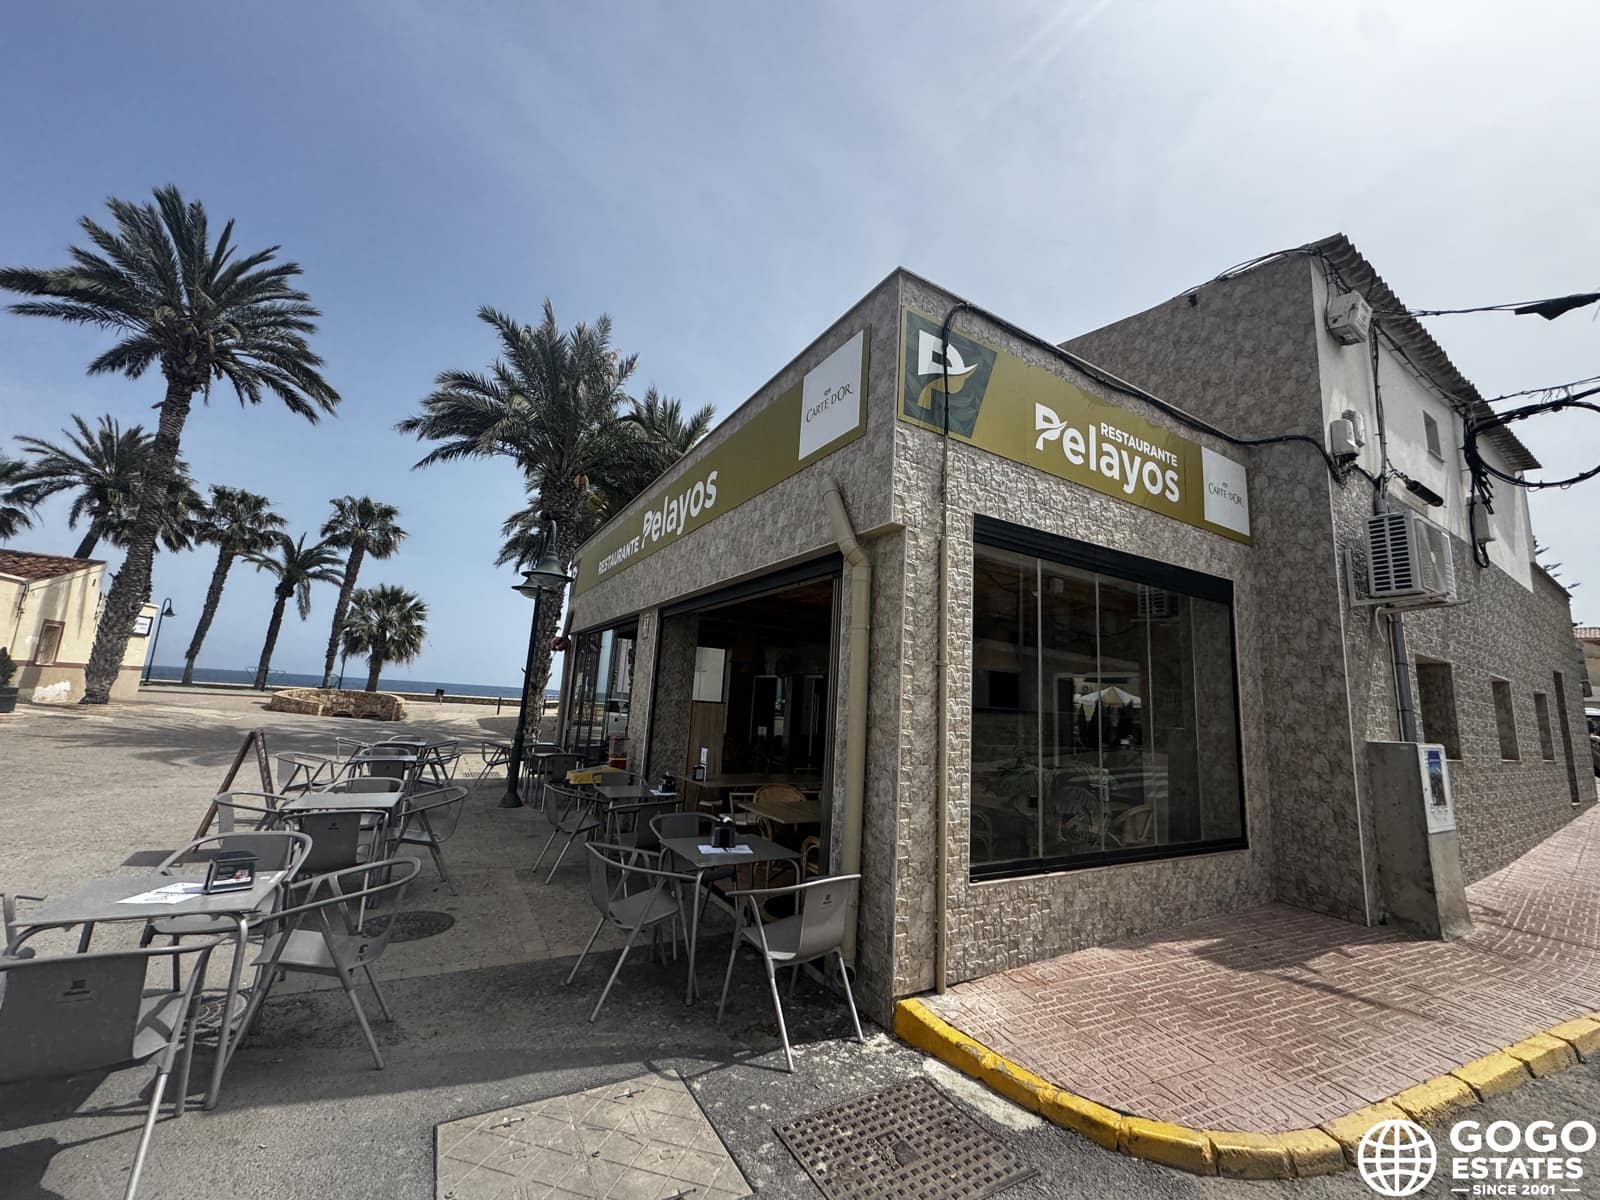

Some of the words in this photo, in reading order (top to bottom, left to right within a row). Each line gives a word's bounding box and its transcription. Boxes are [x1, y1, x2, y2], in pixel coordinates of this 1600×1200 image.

[806, 398, 830, 423] CARTE
[1100, 421, 1179, 467] RESTAURANTE
[1034, 402, 1181, 503] Pelayos
[597, 535, 641, 577] RESTAURANTE
[641, 470, 719, 549] Pelayos
